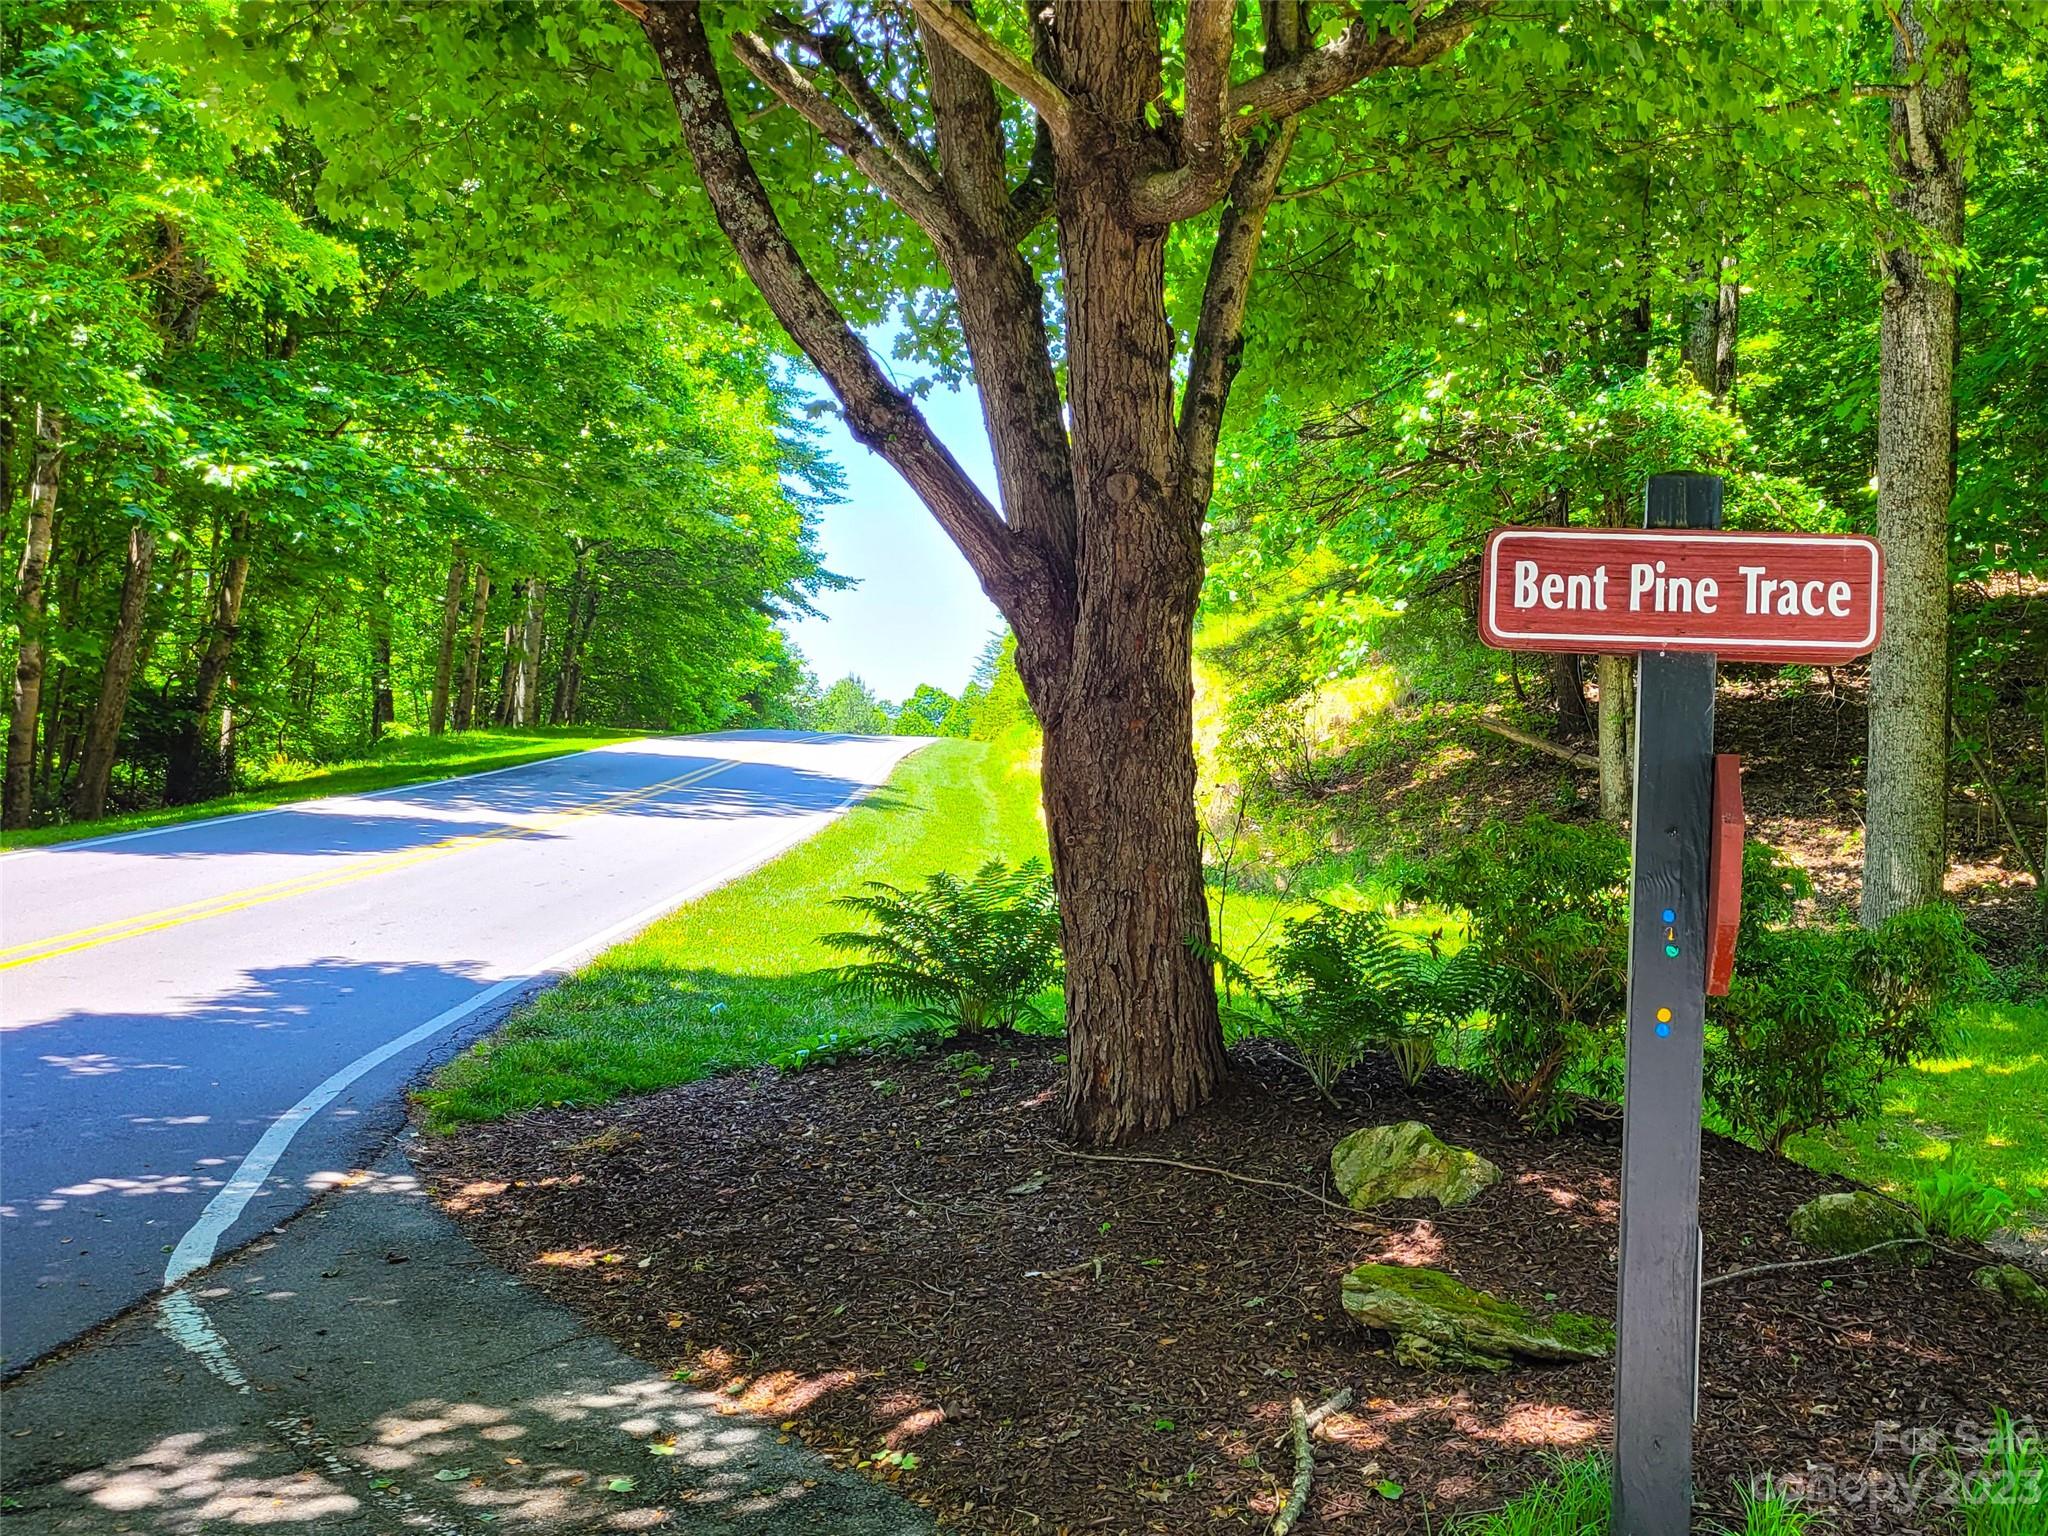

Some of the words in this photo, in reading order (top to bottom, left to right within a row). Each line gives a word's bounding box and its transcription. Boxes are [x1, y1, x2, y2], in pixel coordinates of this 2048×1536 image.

[1514, 560, 1608, 611] Bent
[1630, 560, 1718, 614] Pine
[1739, 566, 1852, 618] Trace
